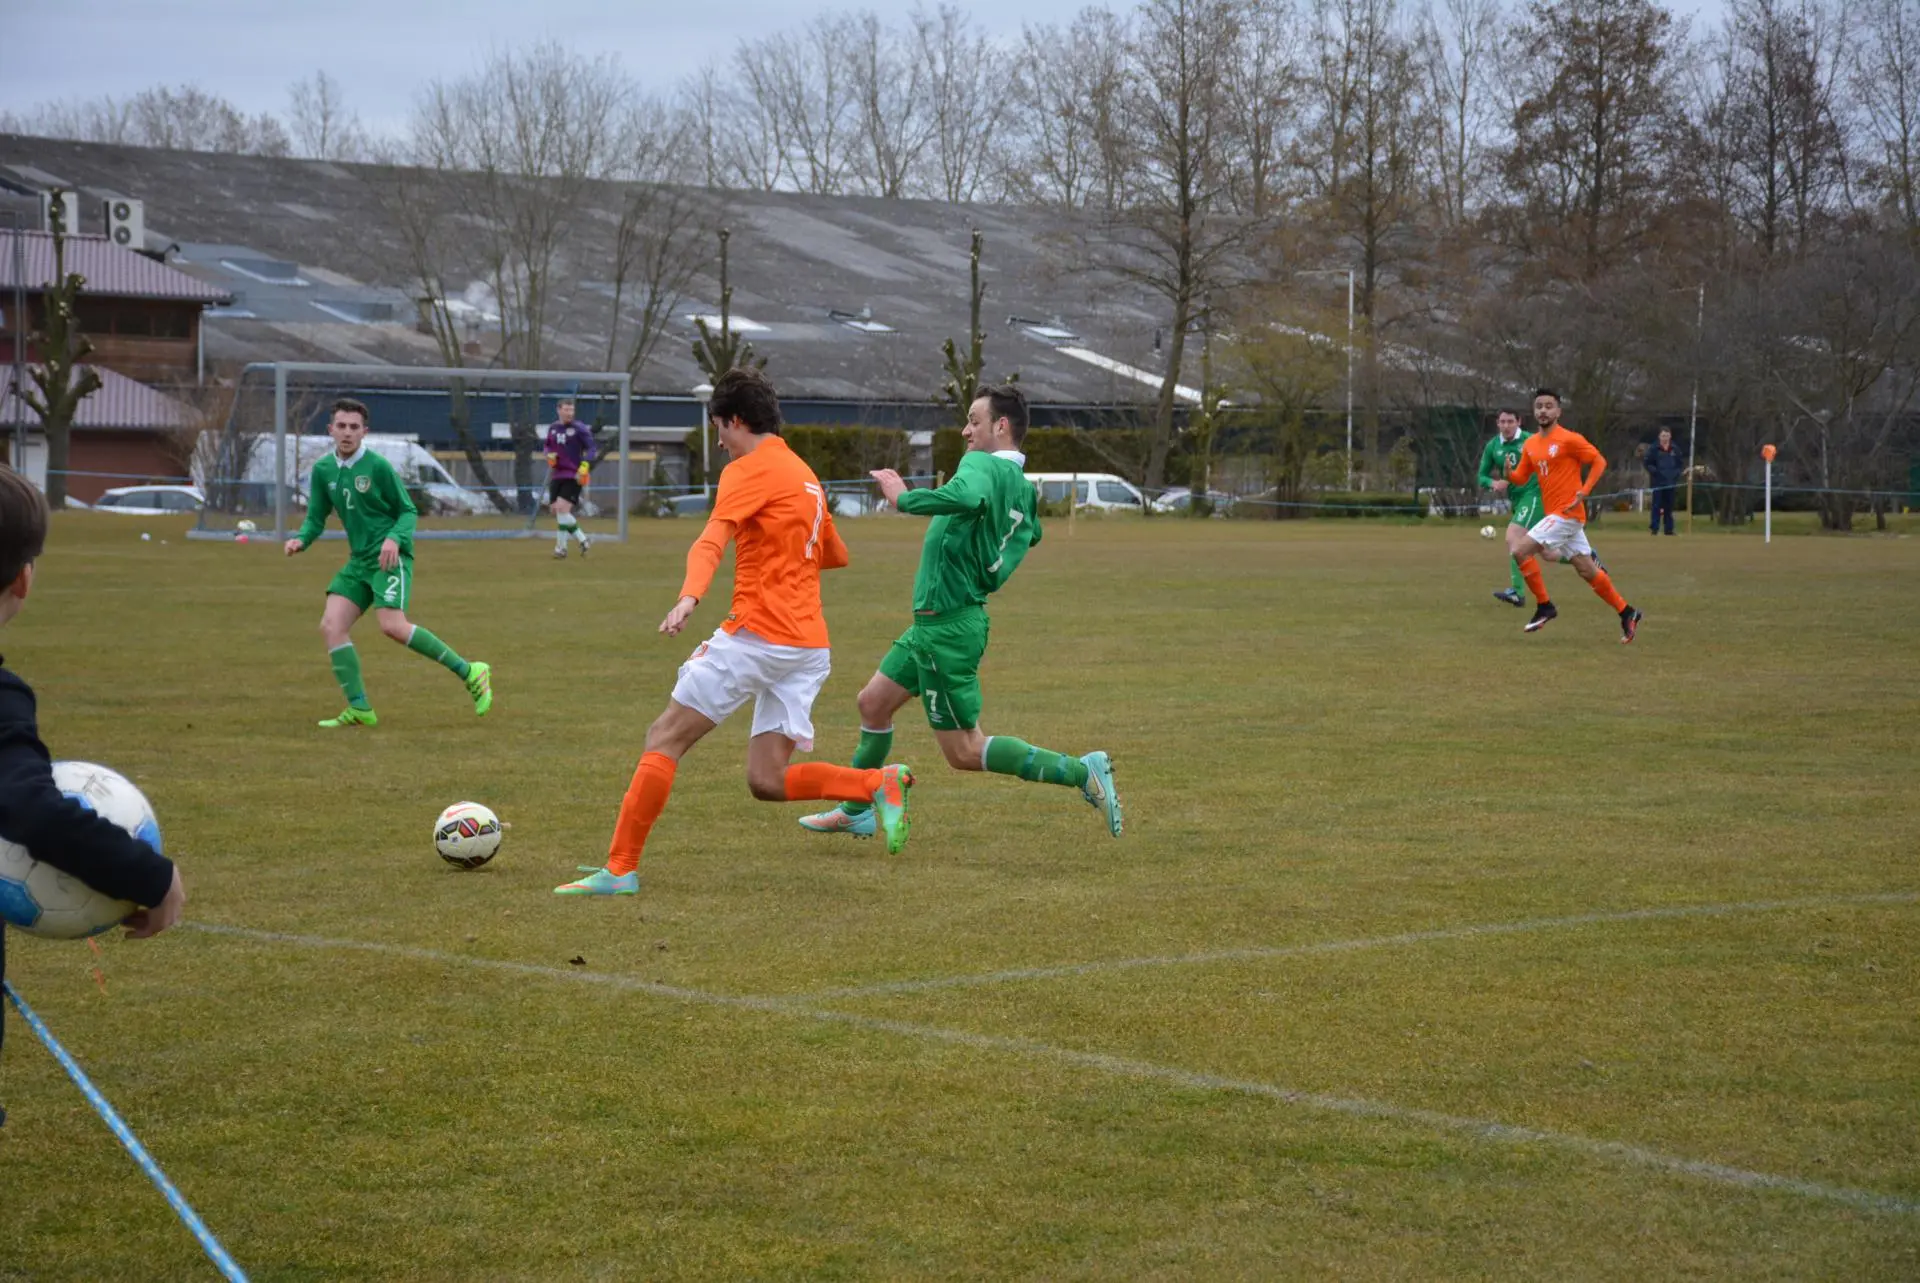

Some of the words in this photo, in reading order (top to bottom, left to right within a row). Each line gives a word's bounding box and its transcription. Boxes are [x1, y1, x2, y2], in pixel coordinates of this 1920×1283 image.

[342, 488, 355, 509] 2
[804, 481, 823, 559] 7
[987, 508, 1024, 573] 7
[385, 575, 400, 596] 2
[926, 689, 937, 712] 7
